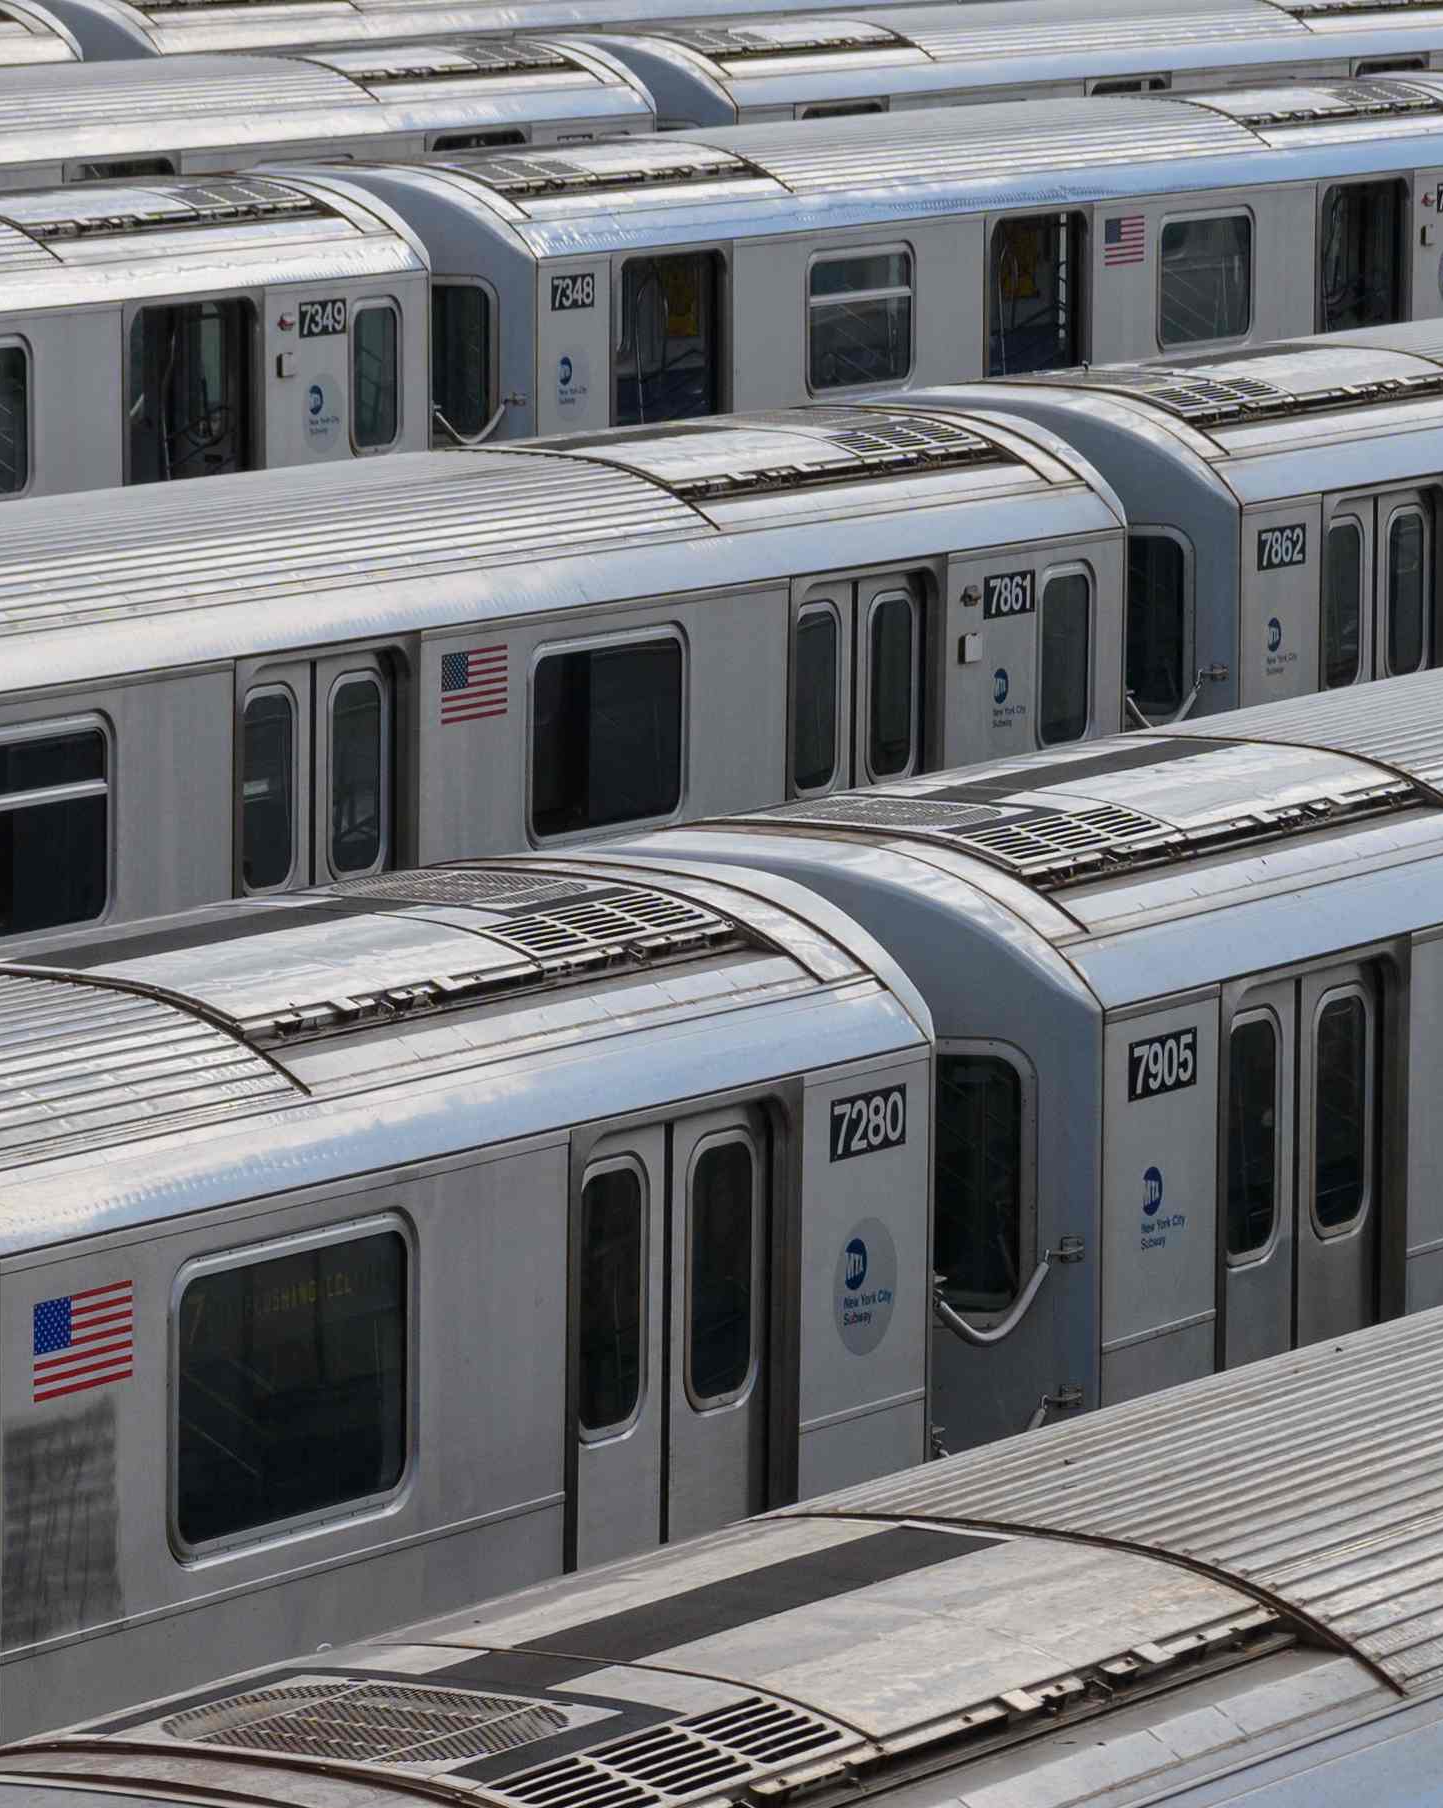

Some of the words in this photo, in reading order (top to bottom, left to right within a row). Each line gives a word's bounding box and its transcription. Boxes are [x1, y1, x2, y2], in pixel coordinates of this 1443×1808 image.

[553, 275, 594, 309] 7348
[300, 300, 346, 336] 7349
[1261, 527, 1303, 566] 7862
[990, 574, 1031, 615] 7861
[1134, 1032, 1194, 1095] 7905
[834, 1091, 902, 1155] 7280
[844, 1296, 859, 1309] New
[859, 1292, 876, 1305] York
[877, 1289, 892, 1304] City
[843, 1310, 871, 1328] Subway
